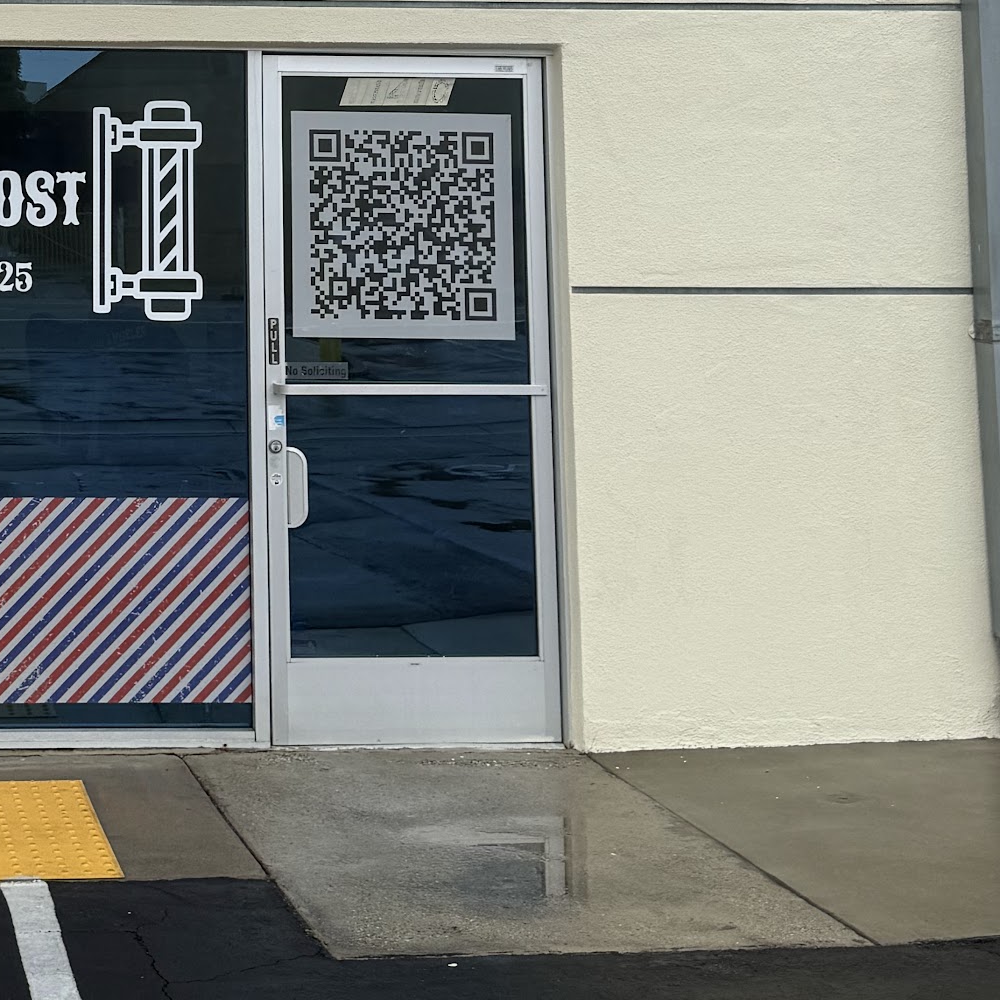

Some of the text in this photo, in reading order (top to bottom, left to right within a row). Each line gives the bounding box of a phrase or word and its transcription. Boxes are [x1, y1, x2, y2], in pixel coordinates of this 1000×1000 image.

[269, 319, 278, 364] PULL
[285, 366, 347, 379] No Soliciting
